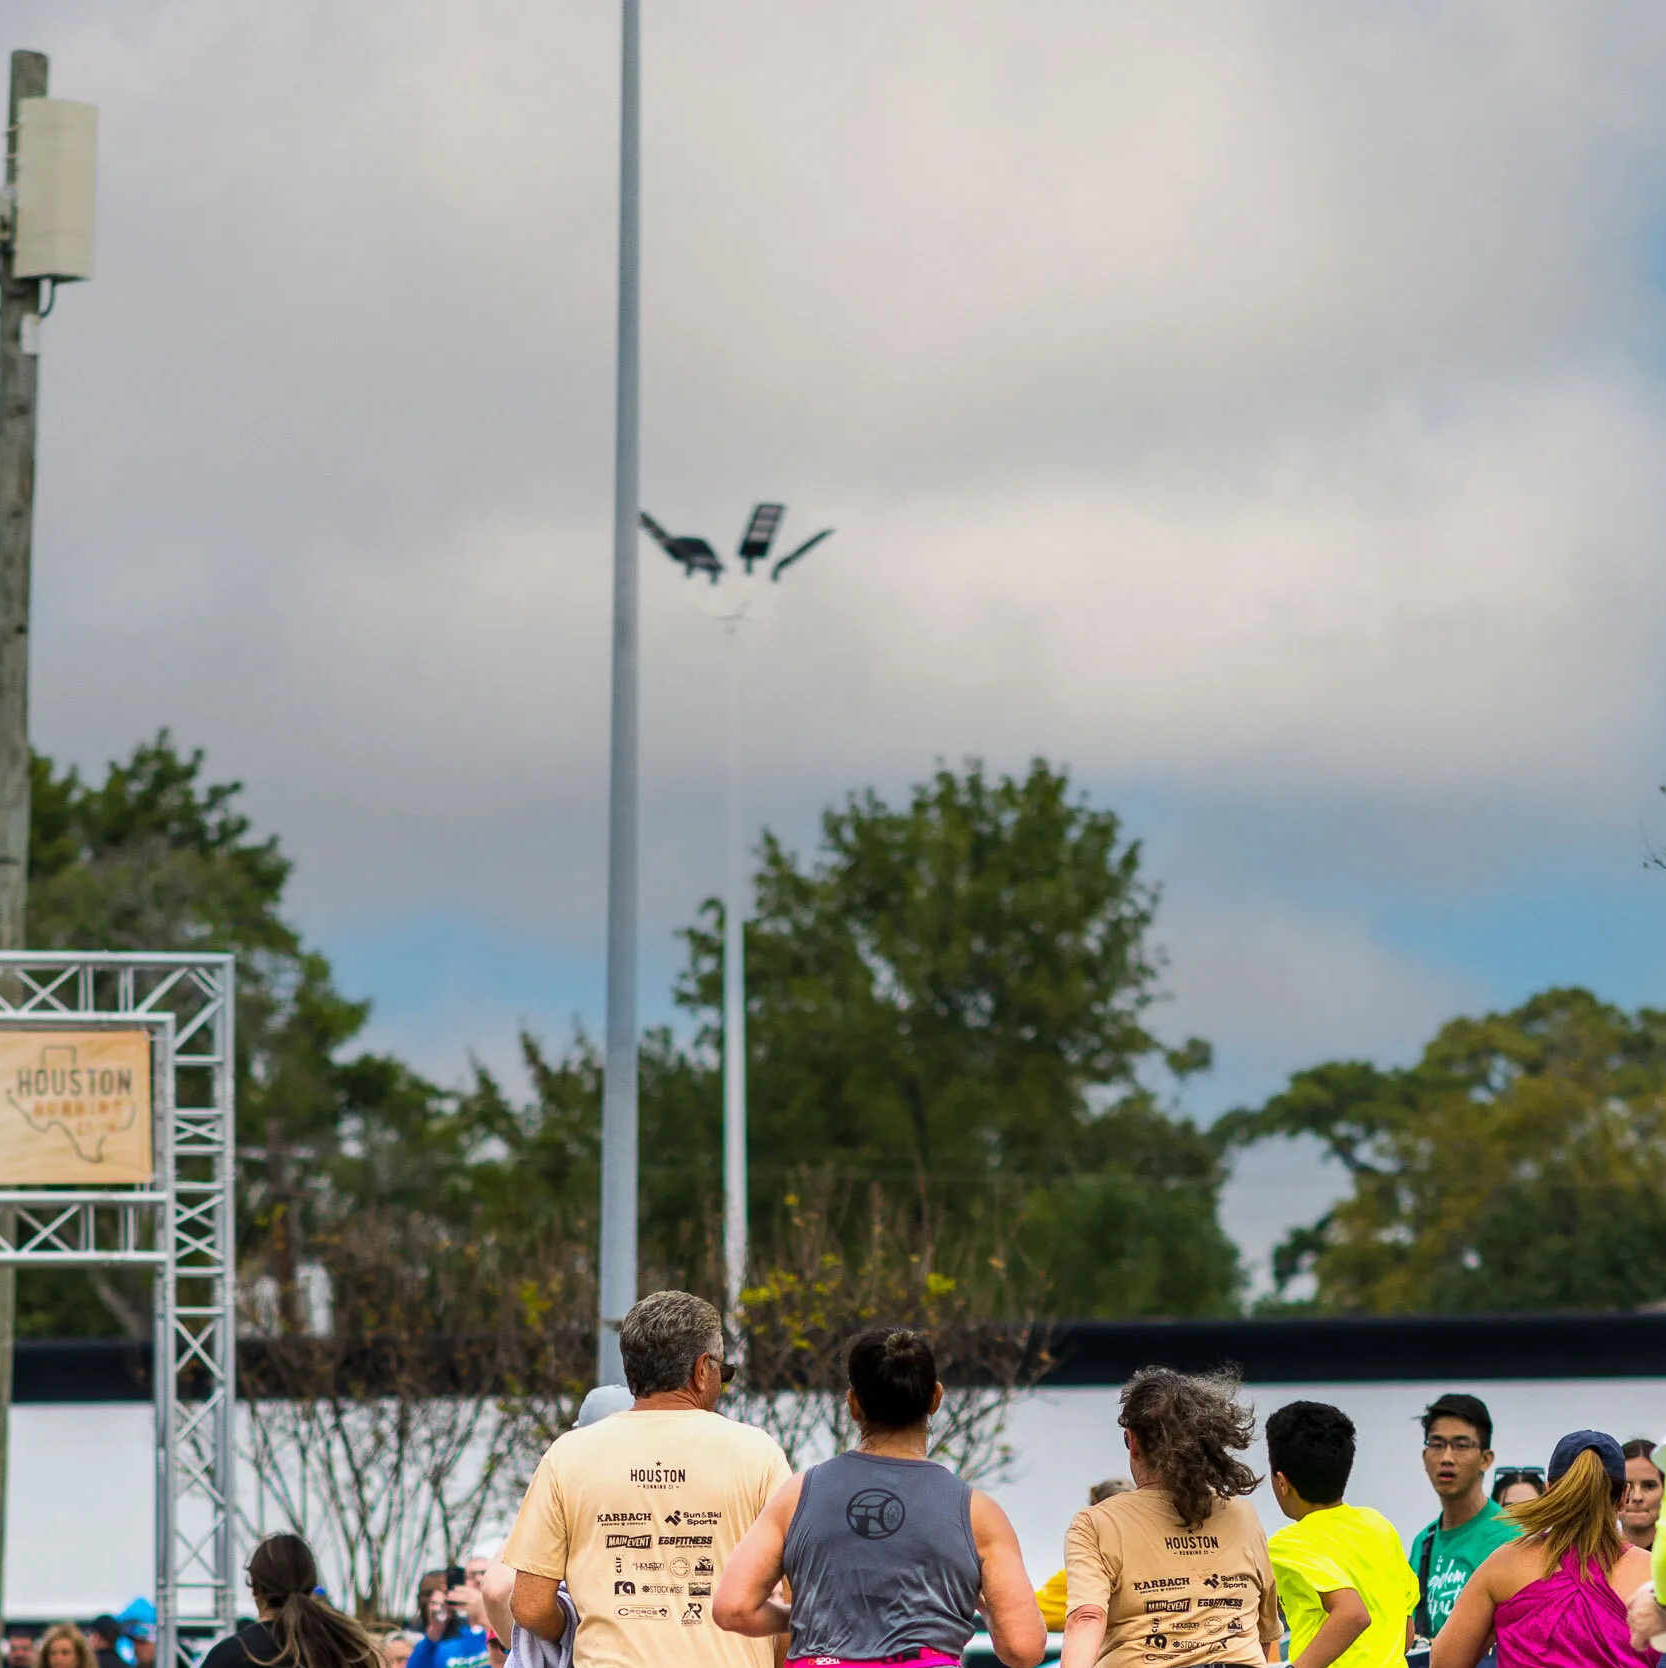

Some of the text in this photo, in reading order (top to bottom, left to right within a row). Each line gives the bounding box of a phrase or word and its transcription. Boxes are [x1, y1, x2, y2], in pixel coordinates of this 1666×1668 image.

[17, 1068, 132, 1096] HOUSTON
[630, 1469, 686, 1483] HOUSTON
[597, 1513, 652, 1523] KARBACH
[608, 1537, 651, 1547] MAIN EVENT
[675, 1536, 713, 1545] FITNESS
[1164, 1536, 1219, 1549] HOUSTON
[615, 1556, 623, 1574] CLIF
[1133, 1577, 1190, 1591] KARBACH
[1148, 1600, 1188, 1611] MAIN EVENT
